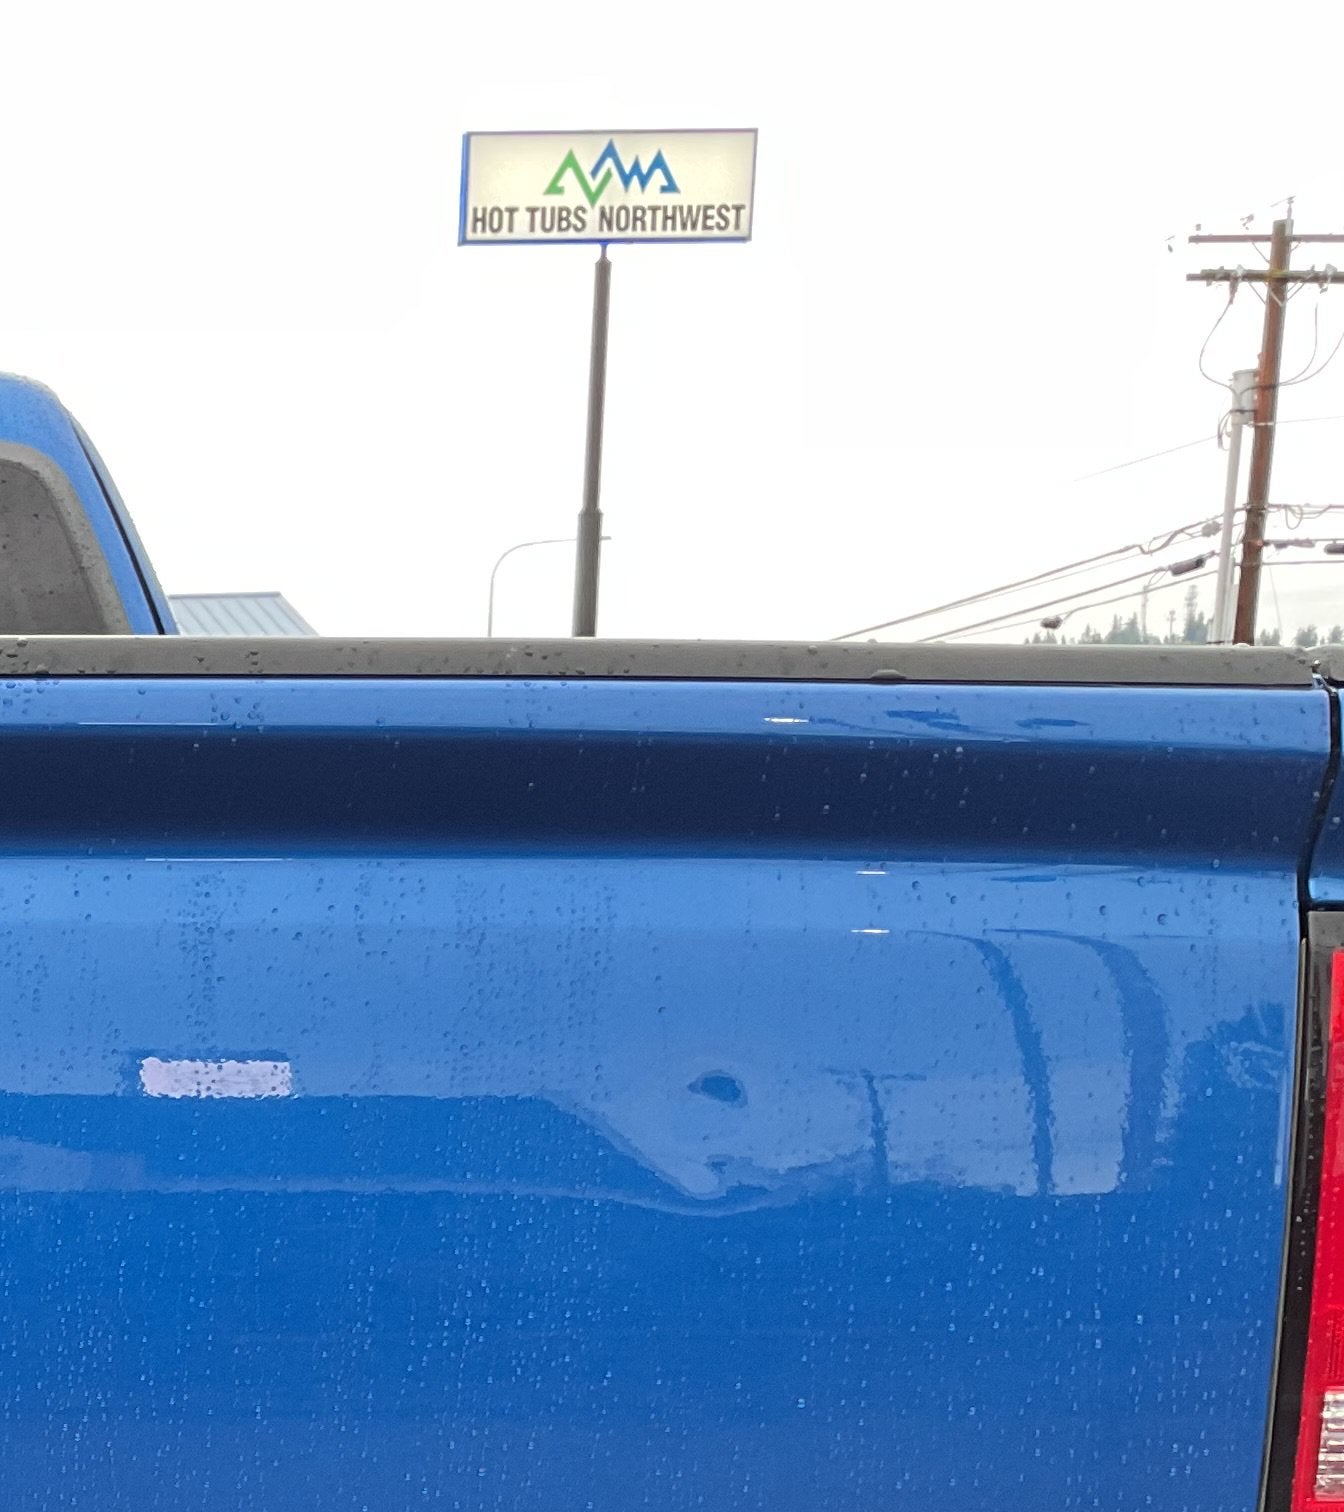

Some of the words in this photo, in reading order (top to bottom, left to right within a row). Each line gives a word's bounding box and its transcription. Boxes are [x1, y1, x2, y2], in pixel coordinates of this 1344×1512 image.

[471, 207, 519, 233] HOT
[525, 206, 587, 233] TUBS
[598, 204, 746, 232] NORTHWEST
